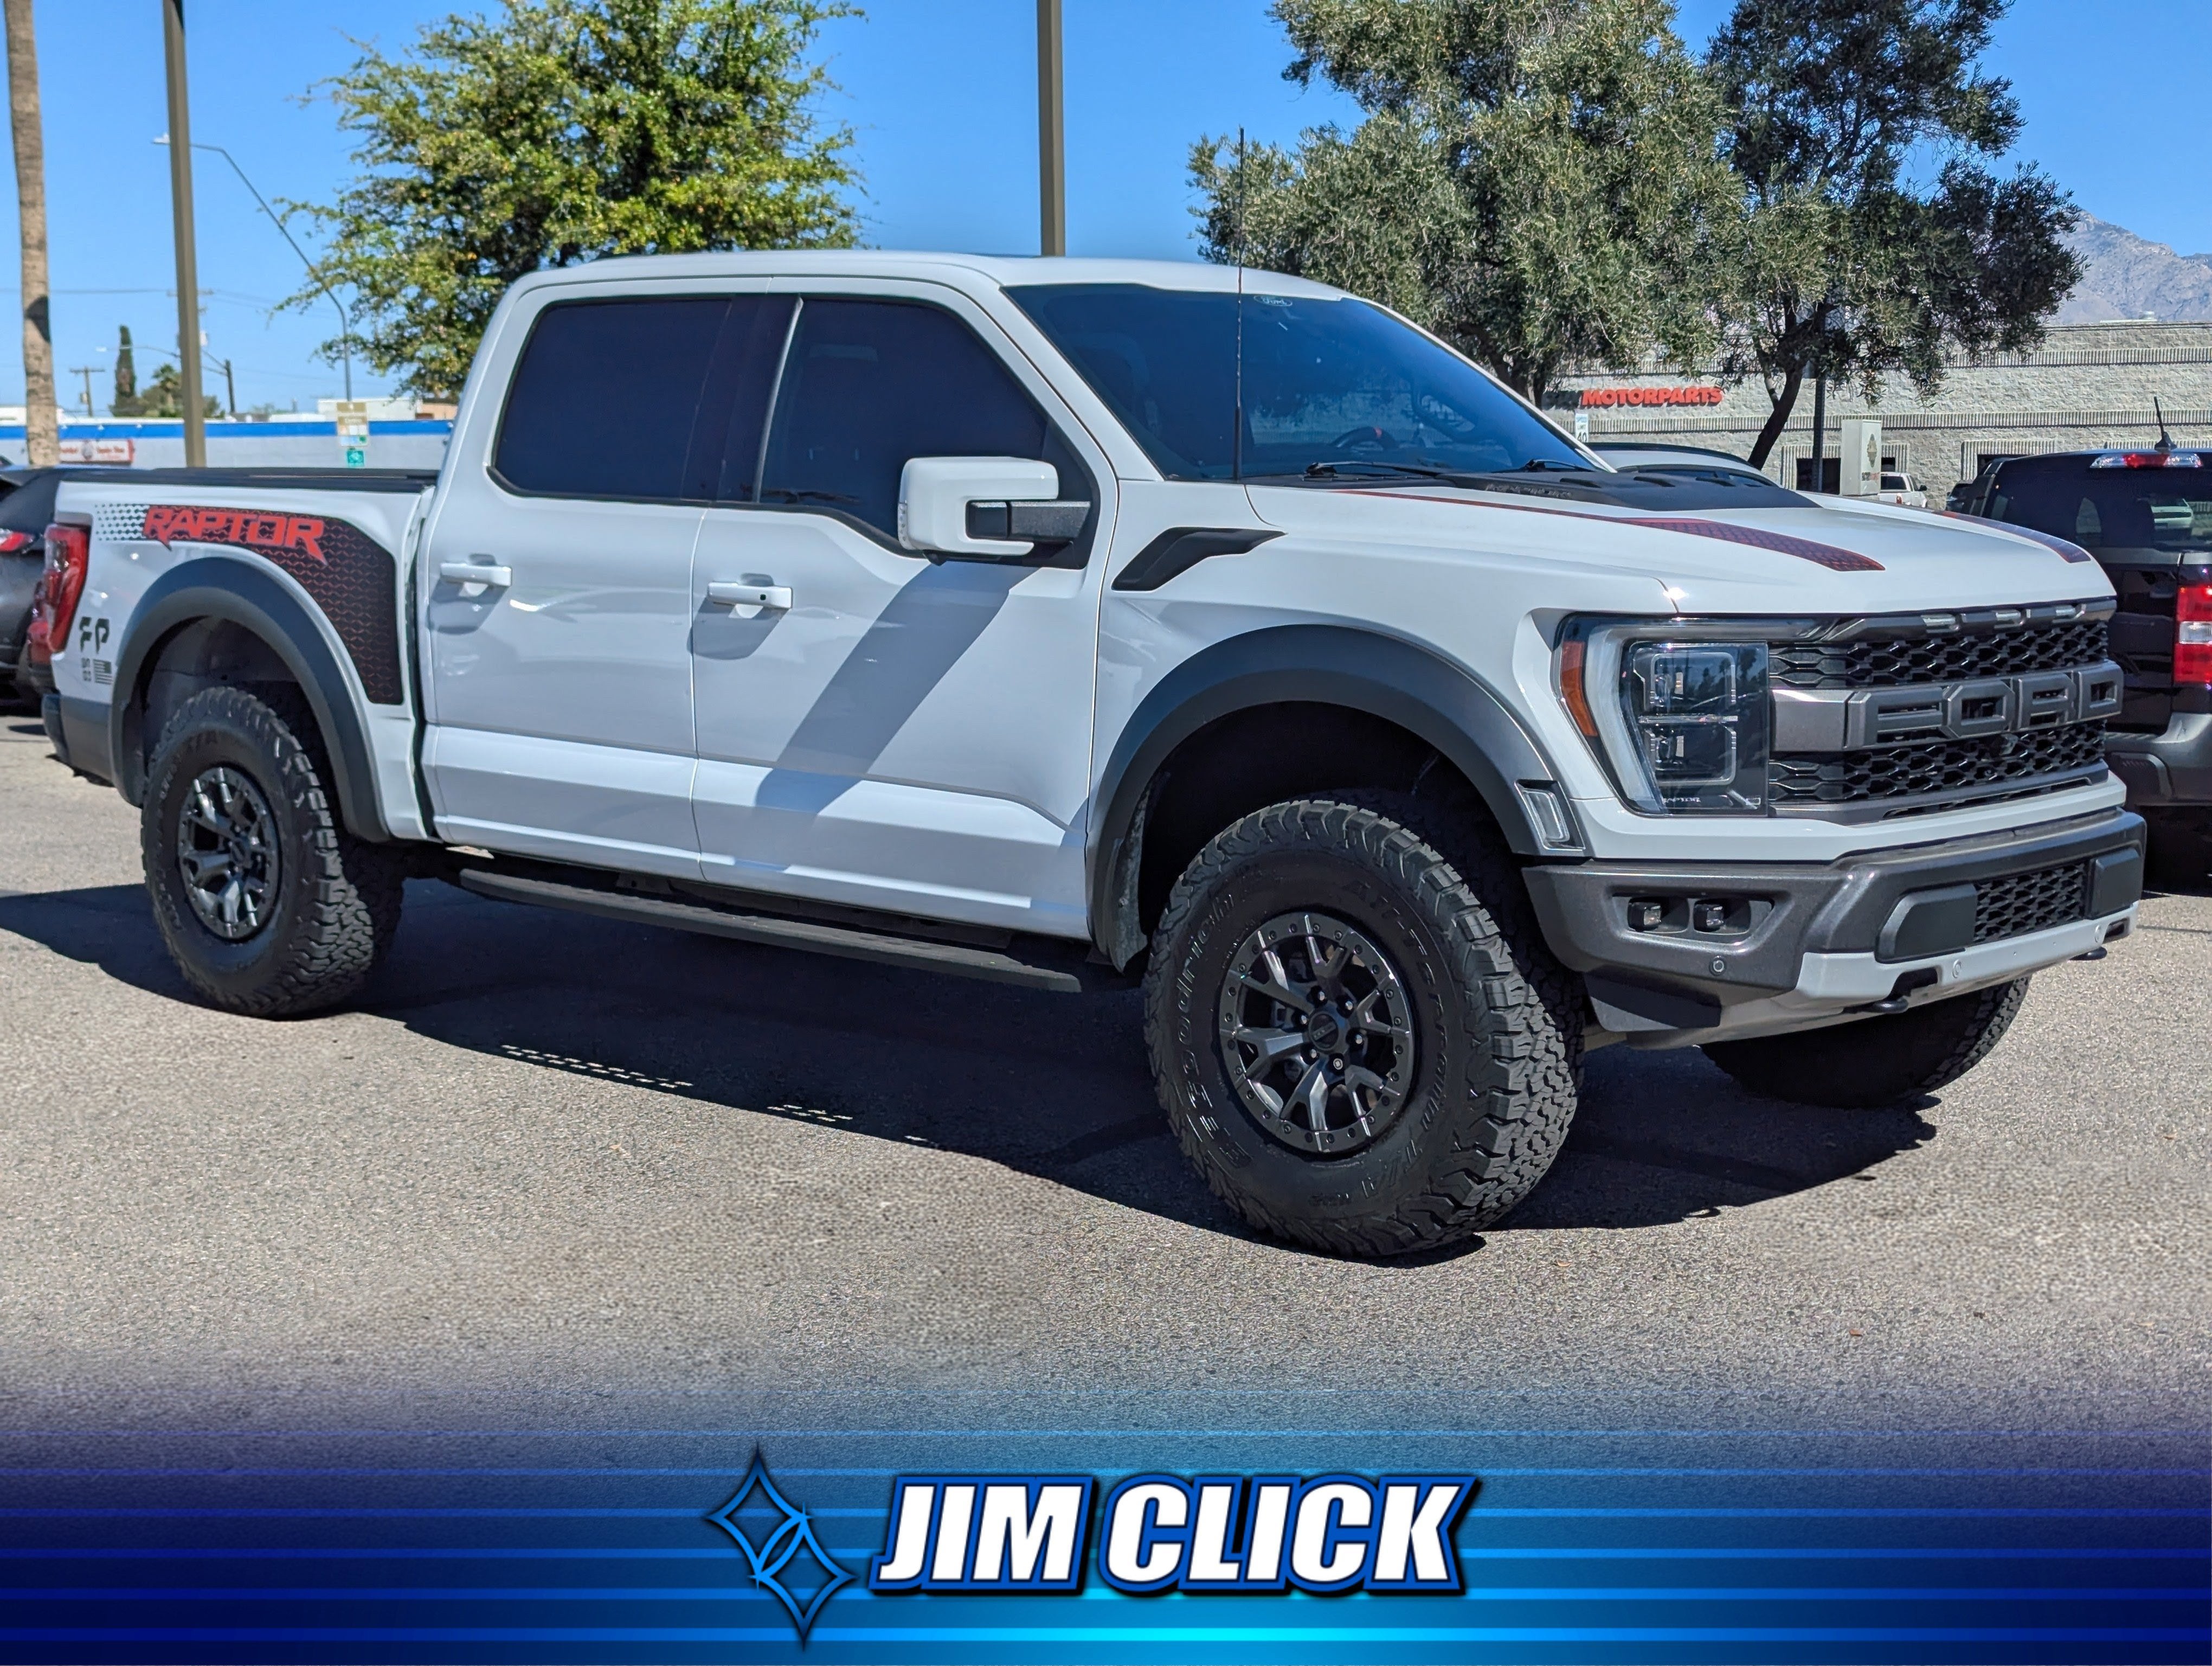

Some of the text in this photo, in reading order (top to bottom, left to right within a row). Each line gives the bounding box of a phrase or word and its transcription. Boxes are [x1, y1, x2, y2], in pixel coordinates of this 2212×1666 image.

[1582, 387, 1723, 406] MOTORPARTS
[142, 506, 327, 566] RAPTOR
[80, 617, 110, 654] FP
[1846, 662, 2124, 750] FORD
